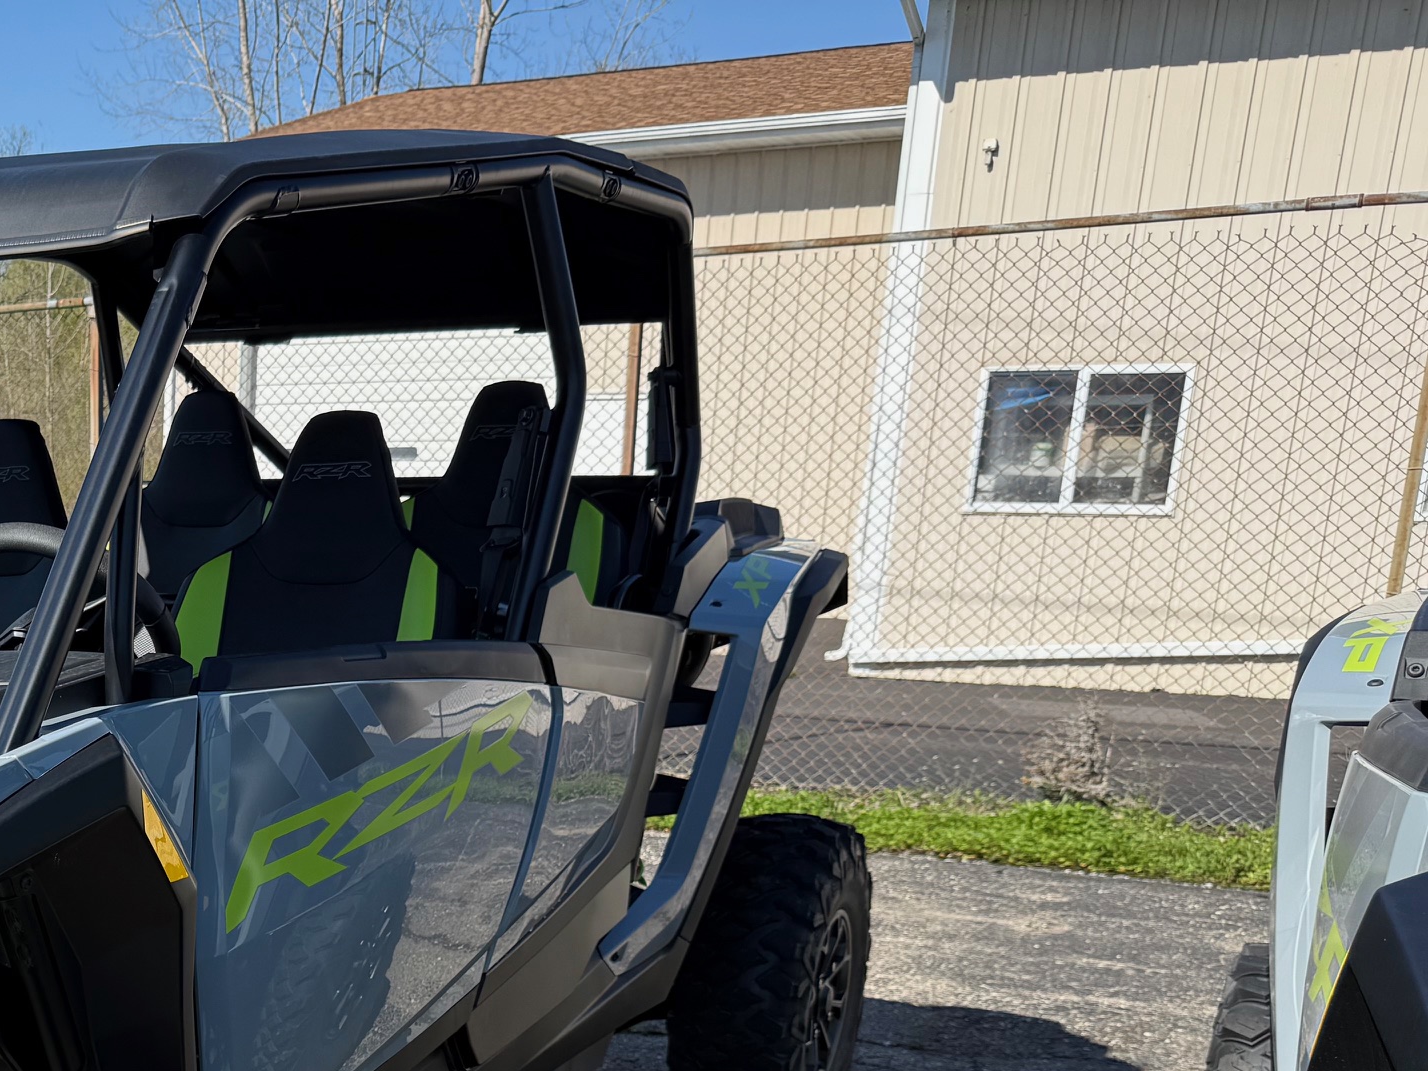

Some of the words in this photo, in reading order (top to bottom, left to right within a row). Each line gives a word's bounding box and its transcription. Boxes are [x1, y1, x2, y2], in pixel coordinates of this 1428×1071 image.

[172, 429, 234, 447] RZR
[291, 460, 373, 483] RZR
[225, 690, 533, 934] RZR
